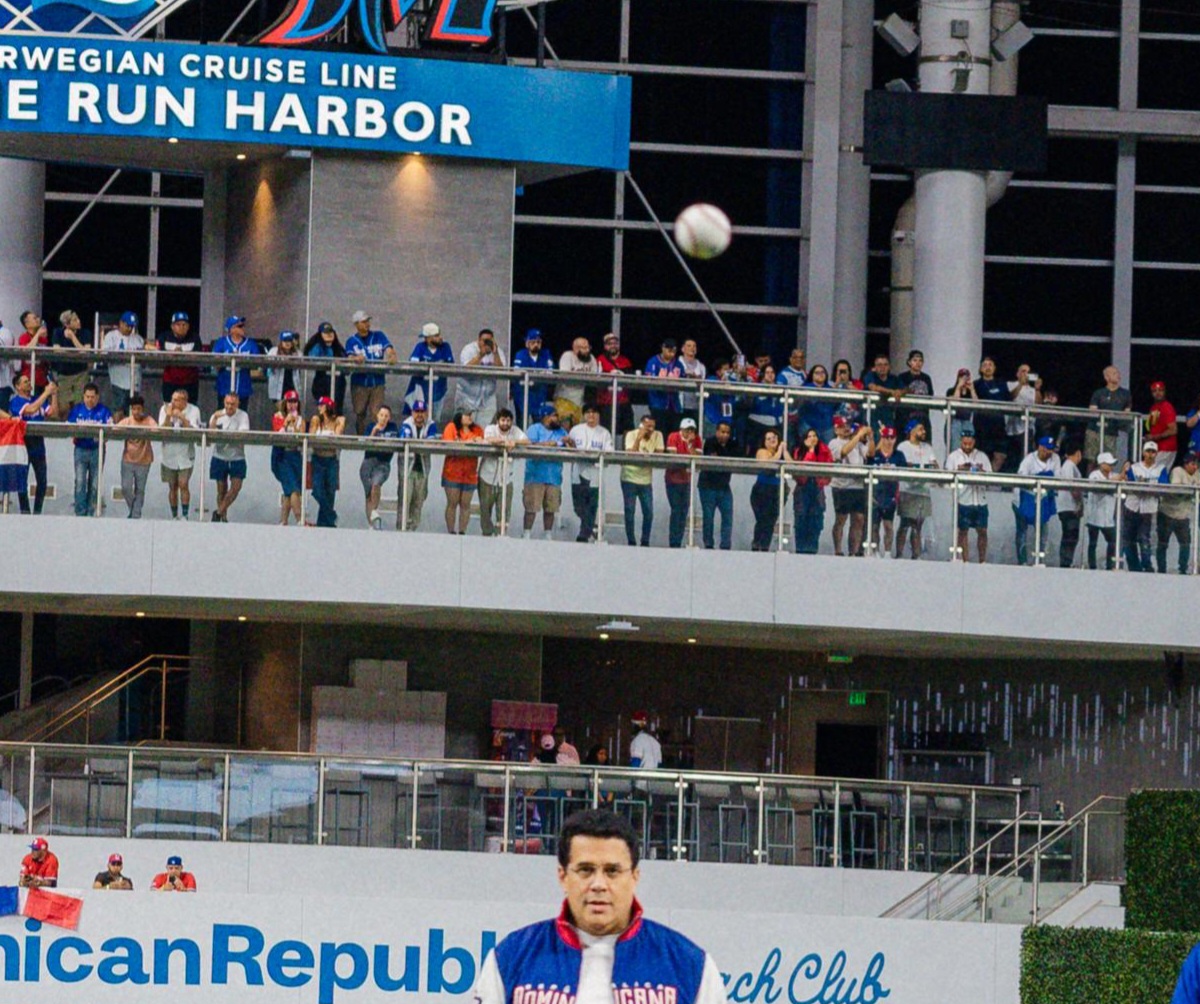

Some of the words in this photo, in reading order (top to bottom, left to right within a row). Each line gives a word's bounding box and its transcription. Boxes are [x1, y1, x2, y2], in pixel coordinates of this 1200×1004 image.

[0, 46, 165, 77] RWEGIAN
[179, 53, 306, 84] CRUISE
[321, 62, 397, 90] LINE
[67, 81, 196, 127] RUN
[225, 89, 473, 146] HARBOR
